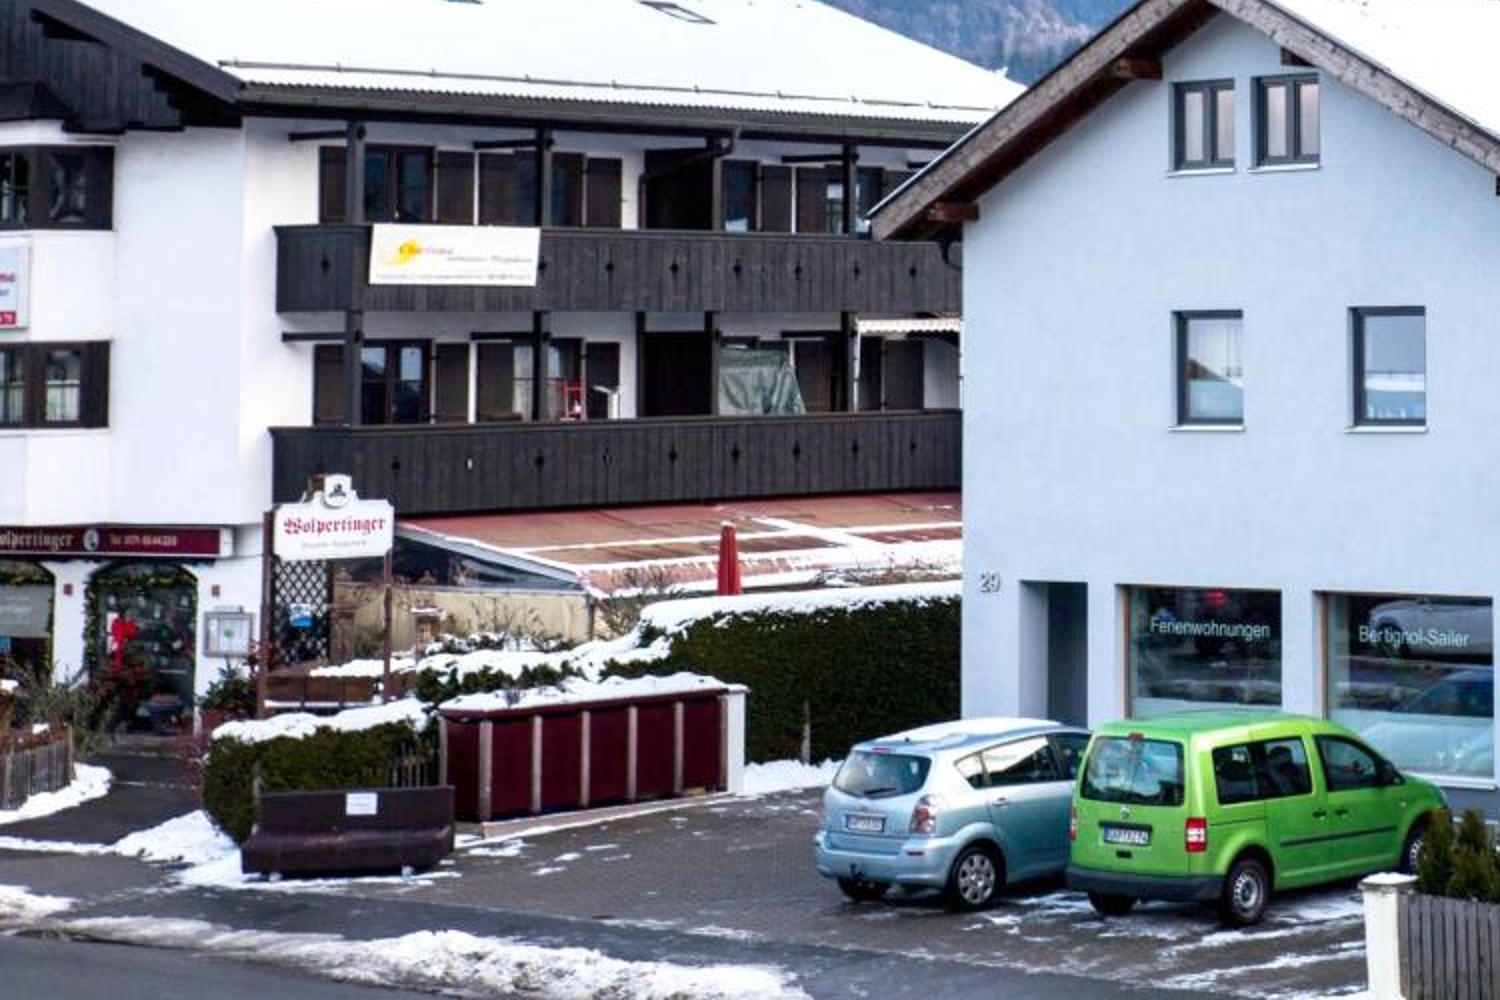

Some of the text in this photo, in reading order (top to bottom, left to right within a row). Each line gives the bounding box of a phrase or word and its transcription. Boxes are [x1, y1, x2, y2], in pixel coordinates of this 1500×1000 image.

[283, 517, 386, 535] Wolpertinger
[979, 570, 1001, 593] 29
[1150, 615, 1271, 642] Ferienwohnungen
